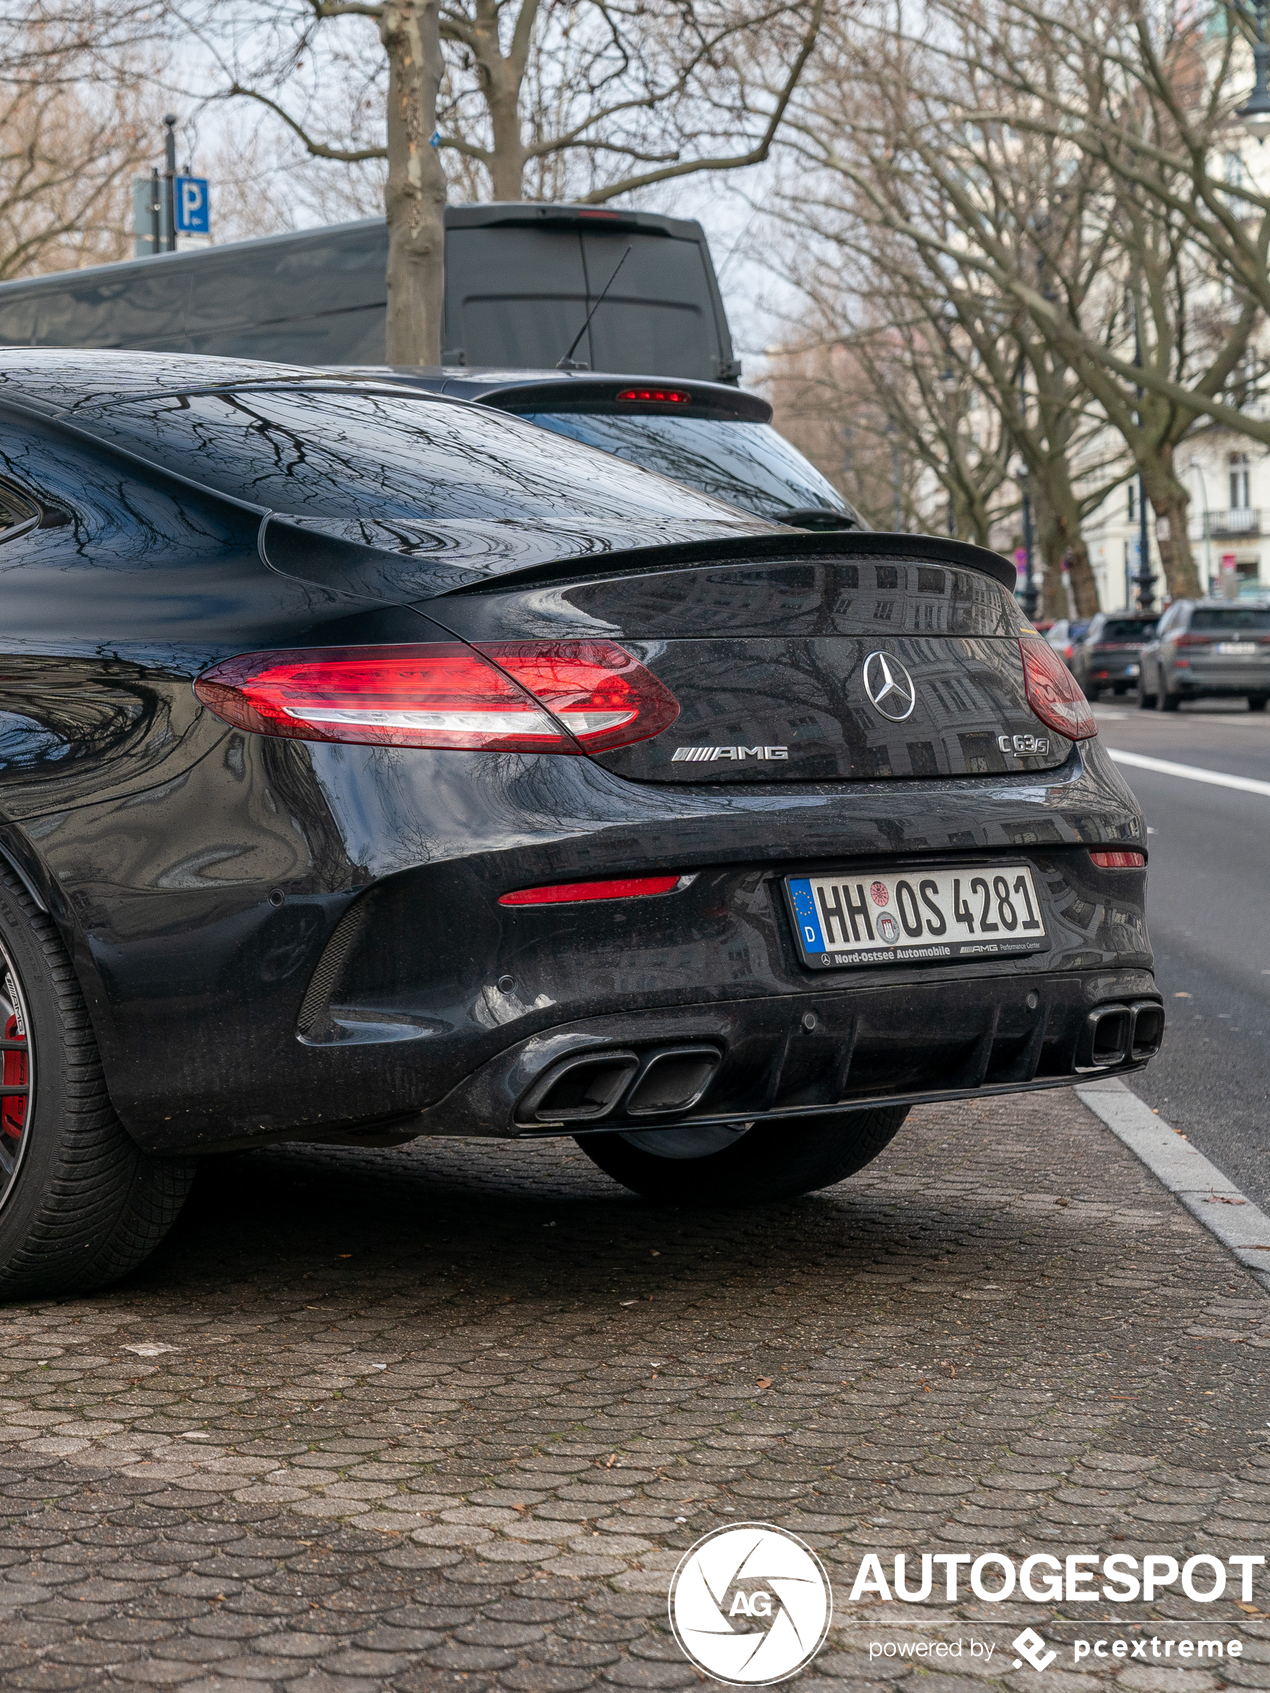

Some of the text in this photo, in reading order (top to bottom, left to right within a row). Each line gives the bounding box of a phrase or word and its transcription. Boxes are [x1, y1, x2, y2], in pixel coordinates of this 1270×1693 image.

[182, 182, 203, 226] P
[804, 875, 1041, 944] D HH OS 4281
[835, 949, 895, 964] Nord-Ostsee
[896, 945, 951, 960] Automobile
[999, 942, 1026, 951] Performance
[1025, 941, 1041, 949] Center
